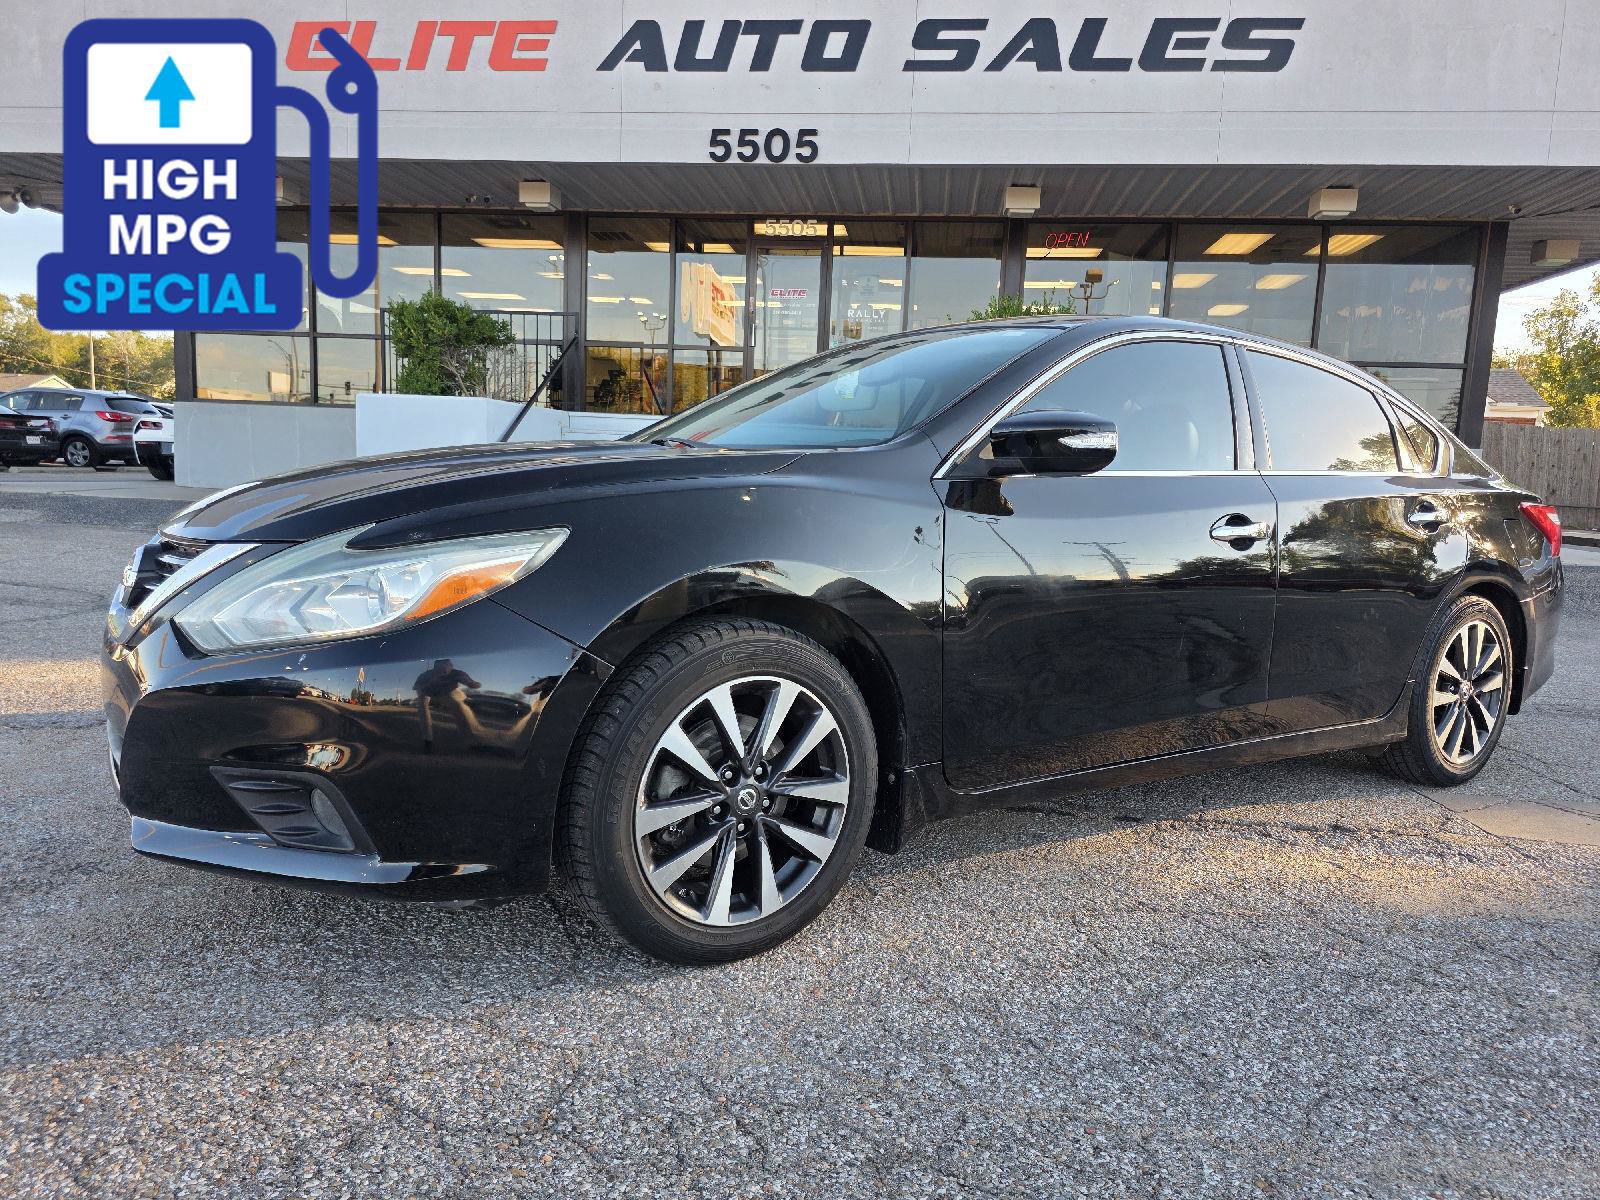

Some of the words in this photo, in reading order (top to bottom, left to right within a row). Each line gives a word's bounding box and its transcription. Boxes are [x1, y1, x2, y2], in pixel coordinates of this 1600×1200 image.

[286, 20, 557, 71] ELITE
[596, 19, 872, 72] AUTO
[903, 17, 1305, 72] SALES
[708, 128, 819, 164] 5505
[765, 219, 818, 237] 5505
[1045, 231, 1090, 249] OPEN
[769, 288, 808, 298] ELITE
[847, 309, 886, 319] RALLY
